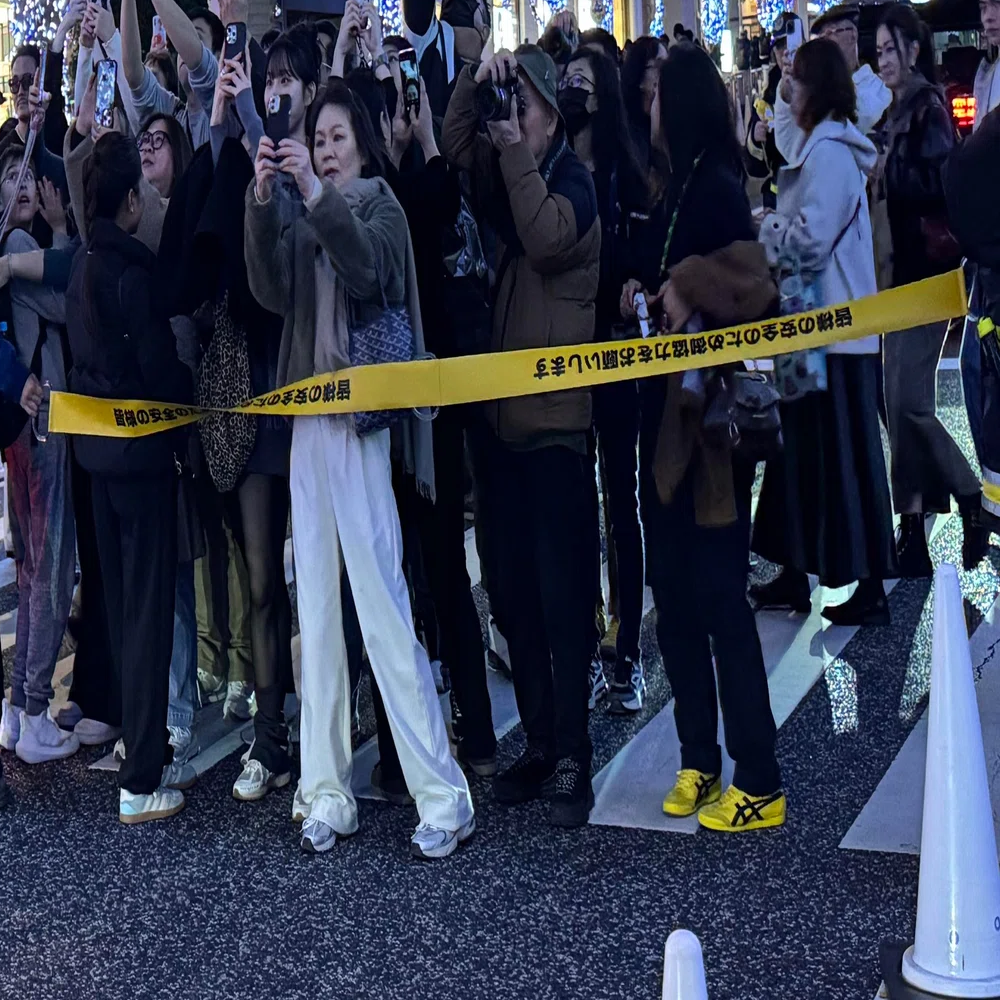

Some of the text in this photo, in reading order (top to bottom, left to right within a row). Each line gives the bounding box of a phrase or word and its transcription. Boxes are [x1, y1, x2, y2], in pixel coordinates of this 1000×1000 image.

[533, 306, 853, 380] 皆様の安全のため御協力をお願いします
